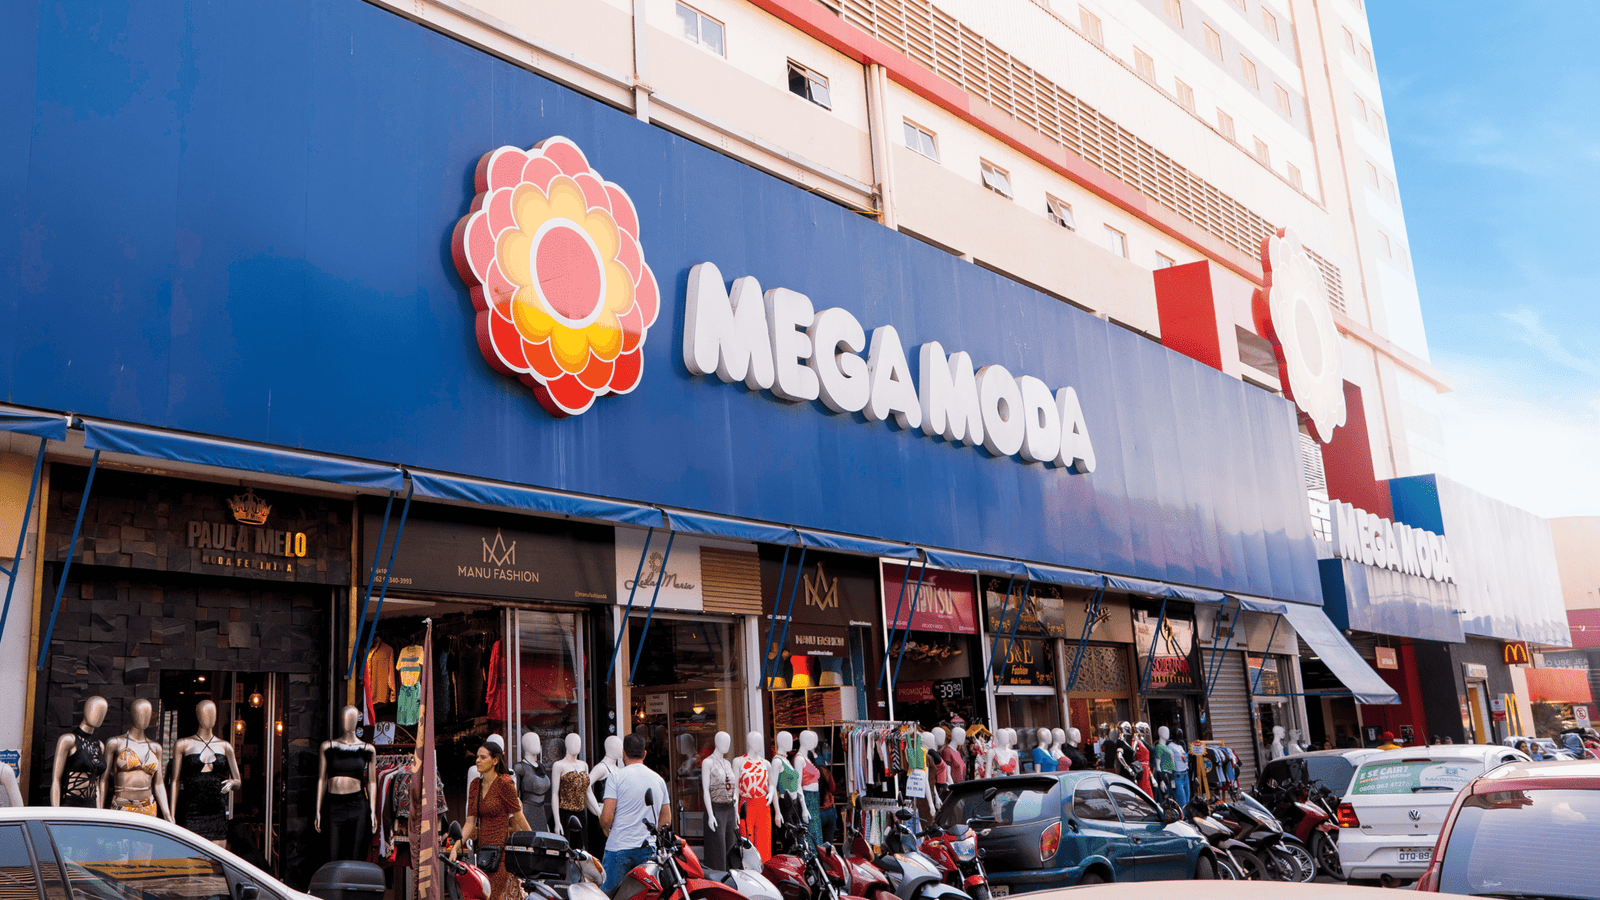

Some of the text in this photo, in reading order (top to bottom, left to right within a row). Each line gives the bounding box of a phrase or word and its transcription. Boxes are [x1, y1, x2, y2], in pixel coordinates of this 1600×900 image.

[187, 520, 307, 558] PAULA MELO
[202, 555, 232, 566] MODA
[457, 565, 540, 583] MANU FASHION
[795, 634, 845, 647] MANU FASHION
[1002, 638, 1034, 664] B&E
[1554, 658, 1571, 666] USE
[1011, 664, 1029, 675] Fashion
[898, 685, 931, 696] PROMOÇÃO
[1360, 766, 1409, 780] E SE CAIR?
[1359, 784, 1376, 793] 0800
